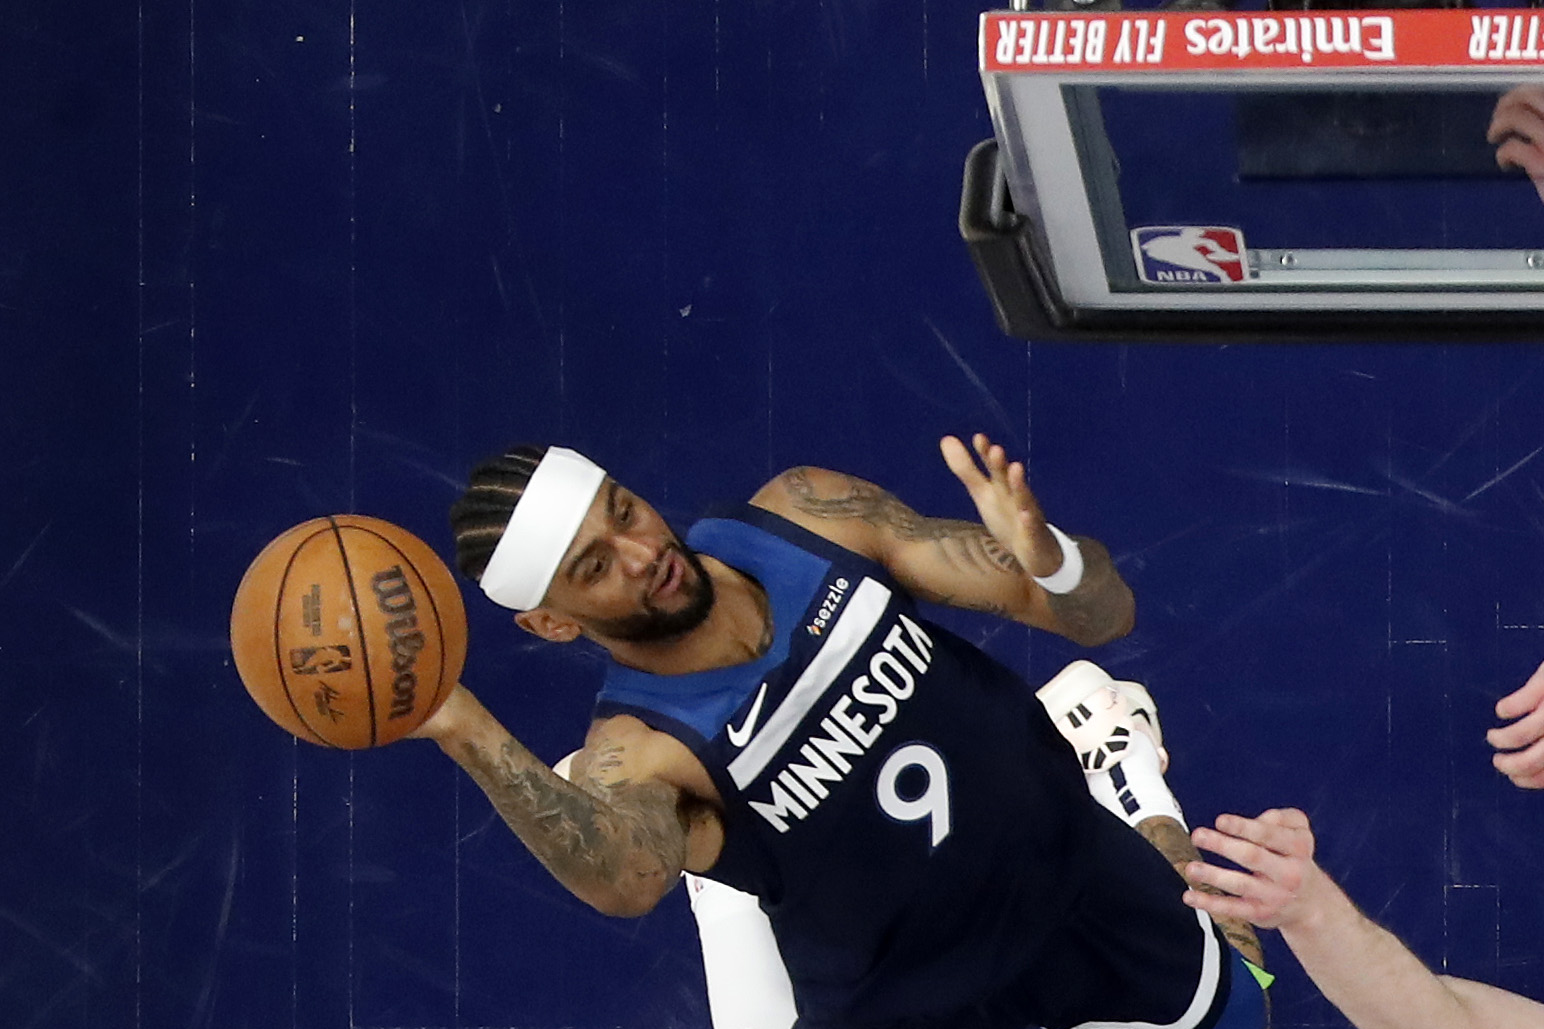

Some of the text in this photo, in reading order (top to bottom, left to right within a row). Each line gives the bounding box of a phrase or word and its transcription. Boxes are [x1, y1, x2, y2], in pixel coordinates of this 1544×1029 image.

[995, 16, 1396, 65] Emirates FLY BETTER
[1156, 270, 1208, 281] NBA
[371, 564, 425, 721] Wilson
[813, 576, 850, 629] sezzle
[748, 613, 935, 834] MINNESOTA
[875, 742, 952, 850] 9
